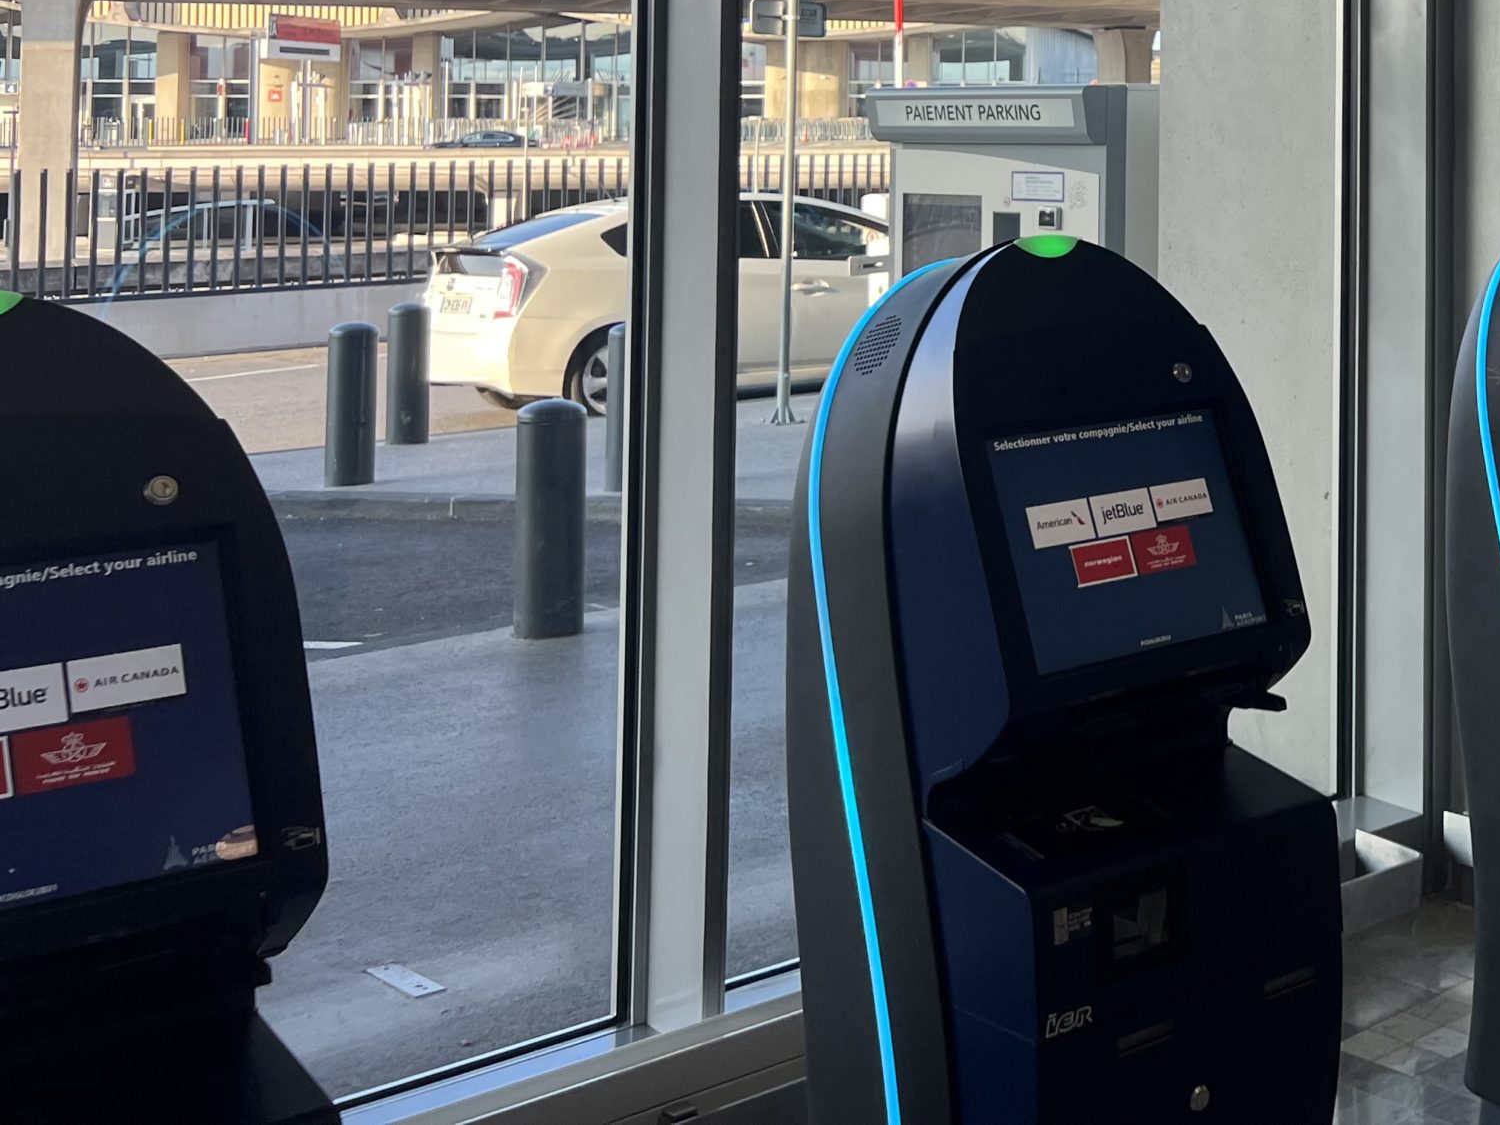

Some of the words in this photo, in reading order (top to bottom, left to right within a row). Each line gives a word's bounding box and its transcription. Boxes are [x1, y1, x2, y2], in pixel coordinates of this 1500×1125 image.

[905, 104, 974, 122] PAIEMENT
[977, 103, 1042, 121] PARKING
[994, 437, 1051, 452] Selectionner
[1053, 432, 1077, 442] votre
[1079, 420, 1156, 439] compagnie/Select
[1156, 417, 1176, 430] your
[1178, 413, 1203, 425] airline
[1165, 497, 1178, 507] AIR
[1178, 492, 1208, 503] CANADA
[1036, 516, 1073, 531] American
[1101, 503, 1144, 524] jetBlue
[104, 556, 144, 575] your
[146, 549, 198, 566] airline
[1084, 555, 1123, 568] norwegian
[93, 675, 119, 689] AIR
[120, 666, 179, 684] CANADA
